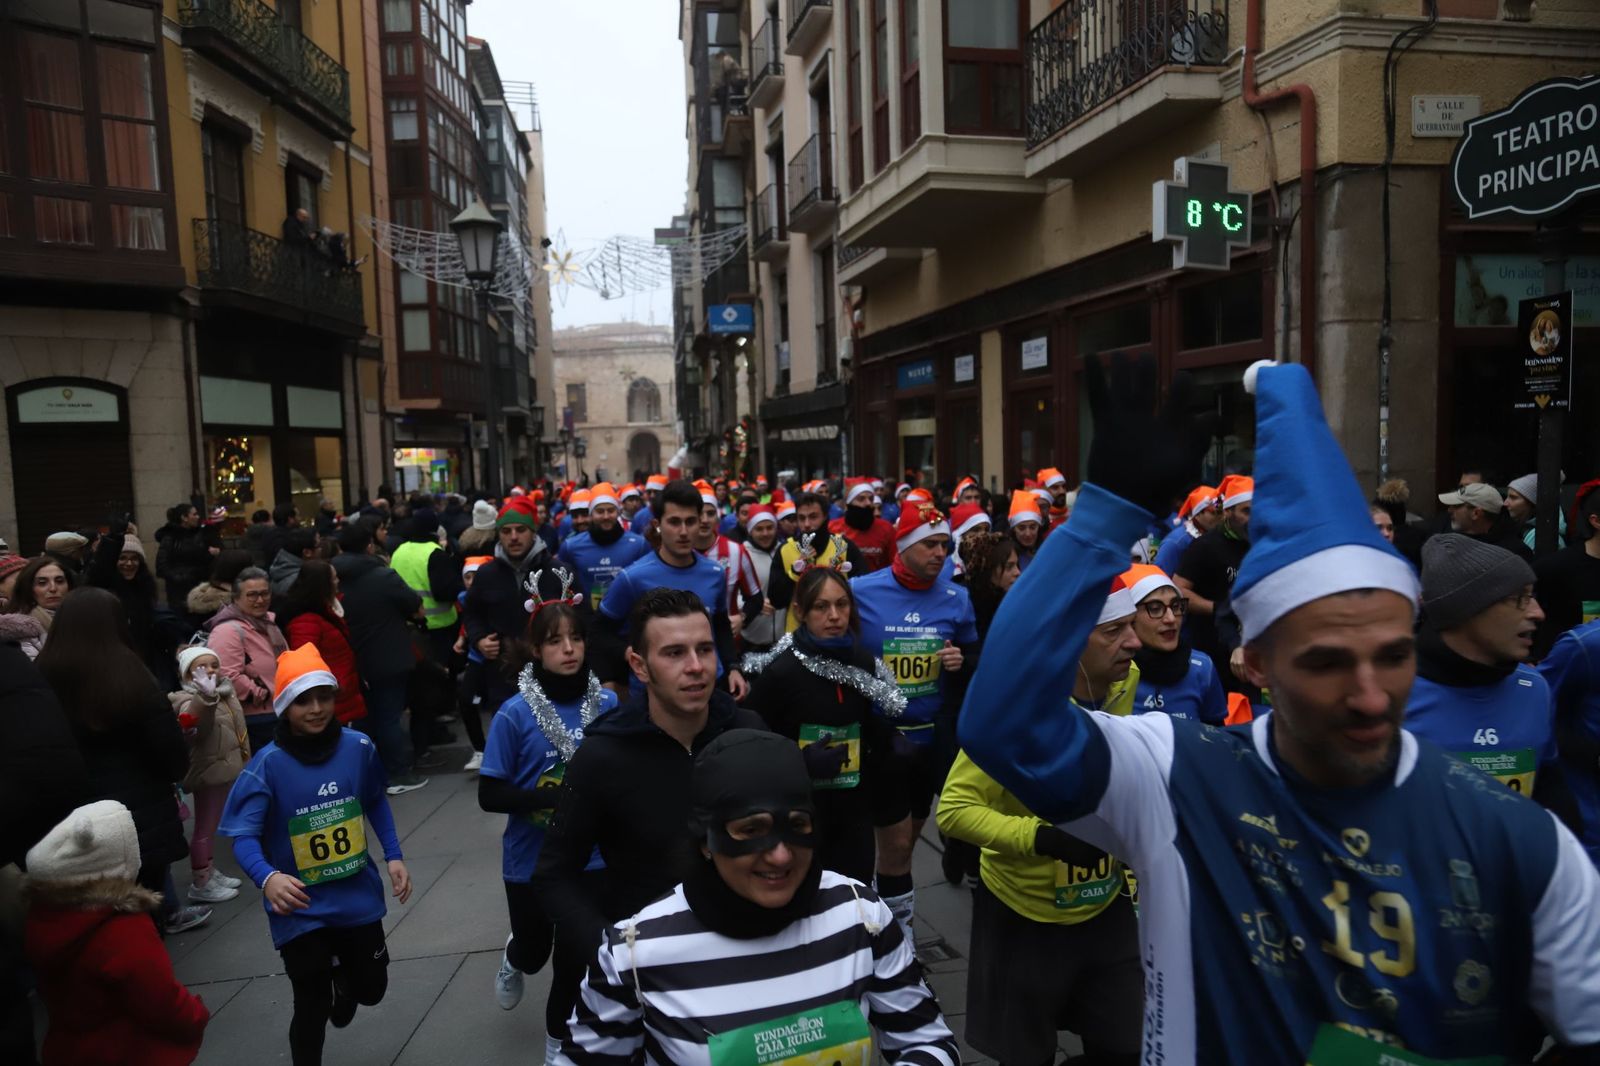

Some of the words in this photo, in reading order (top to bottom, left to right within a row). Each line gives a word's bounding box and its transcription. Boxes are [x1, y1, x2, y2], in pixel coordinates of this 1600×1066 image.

[1436, 101, 1465, 110] CALLE
[1441, 112, 1455, 121] DE
[1492, 103, 1598, 157] TEATRO
[1478, 144, 1600, 200] PRINCIPA
[1187, 199, 1202, 228] 8
[1212, 202, 1243, 231] °C
[1499, 265, 1515, 279] Un
[1526, 282, 1543, 297] de
[903, 612, 921, 624] 46
[890, 656, 931, 680] 1061
[1473, 728, 1500, 746] 46
[318, 781, 339, 797] 46
[295, 806, 310, 816] SAN
[310, 798, 345, 812] SILVESTRE
[310, 826, 352, 861] 68
[322, 866, 345, 876] CAJA
[1080, 886, 1105, 898] CAJA
[1320, 878, 1416, 979] 19
[756, 1037, 785, 1056] CAJA
[786, 1027, 827, 1049] RURAL
[758, 1054, 769, 1064] DE
[769, 1049, 797, 1062] ZAMORA
